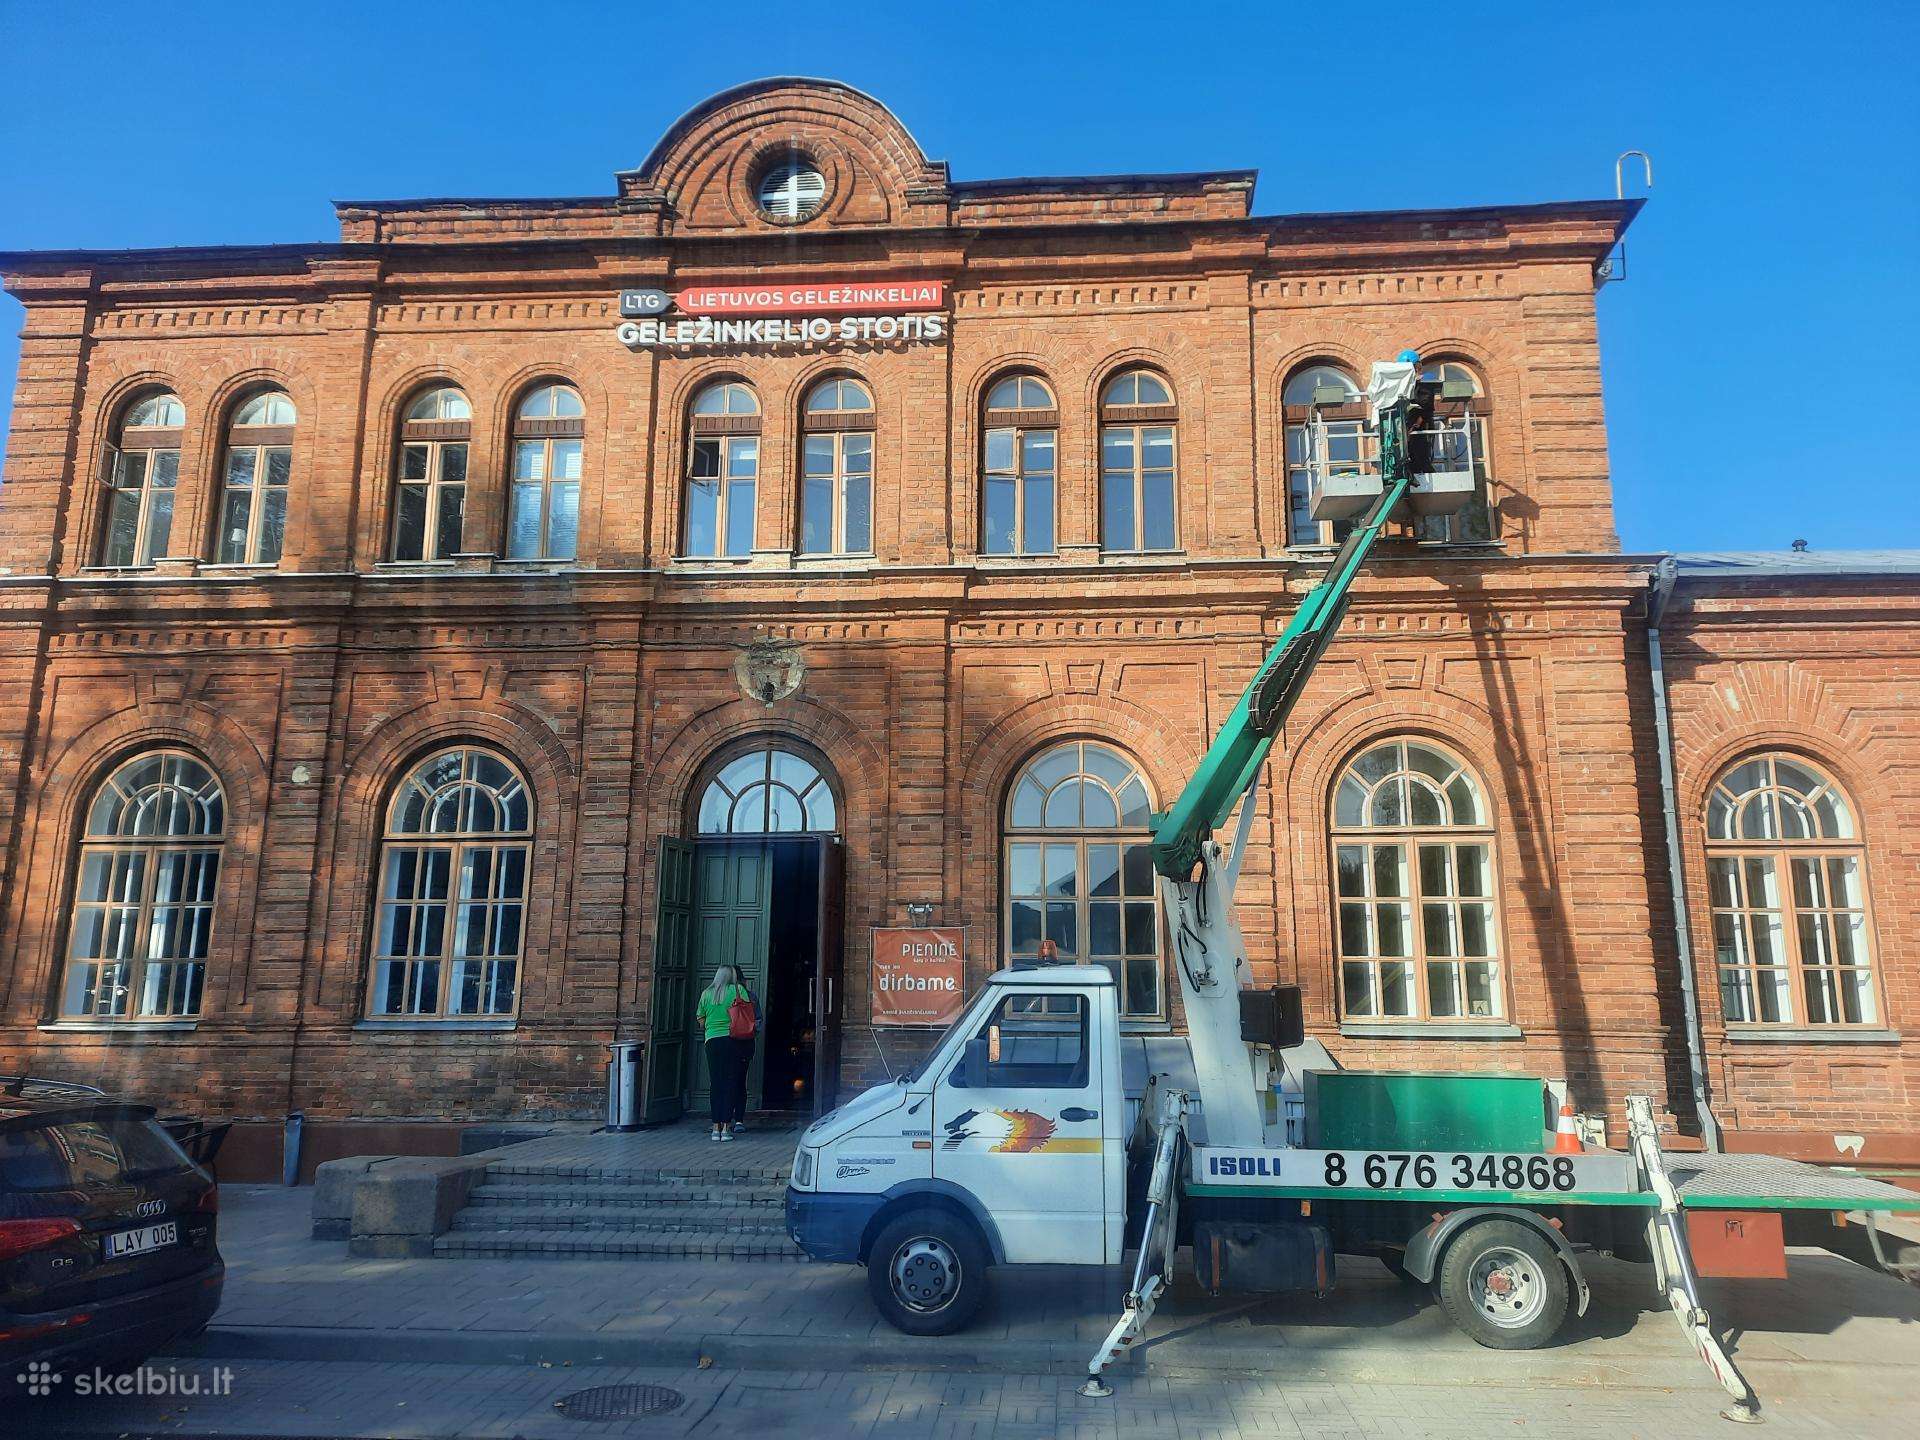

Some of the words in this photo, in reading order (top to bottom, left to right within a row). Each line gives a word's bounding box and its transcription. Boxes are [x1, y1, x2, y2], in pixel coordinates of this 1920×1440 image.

[625, 293, 660, 309] LTG
[688, 290, 784, 308] LIETUVOS
[789, 285, 938, 305] GELEŽINKELIAI
[616, 316, 832, 345] GELEŽINKELIO
[839, 315, 943, 341] STOTIS
[879, 973, 955, 991] dirbame
[1209, 1156, 1281, 1177] ISOLI
[1324, 1152, 1347, 1188] 8
[1363, 1153, 1437, 1189] 676
[1451, 1154, 1576, 1191] 34868
[112, 1229, 144, 1254] LAY
[152, 1225, 176, 1245] 005
